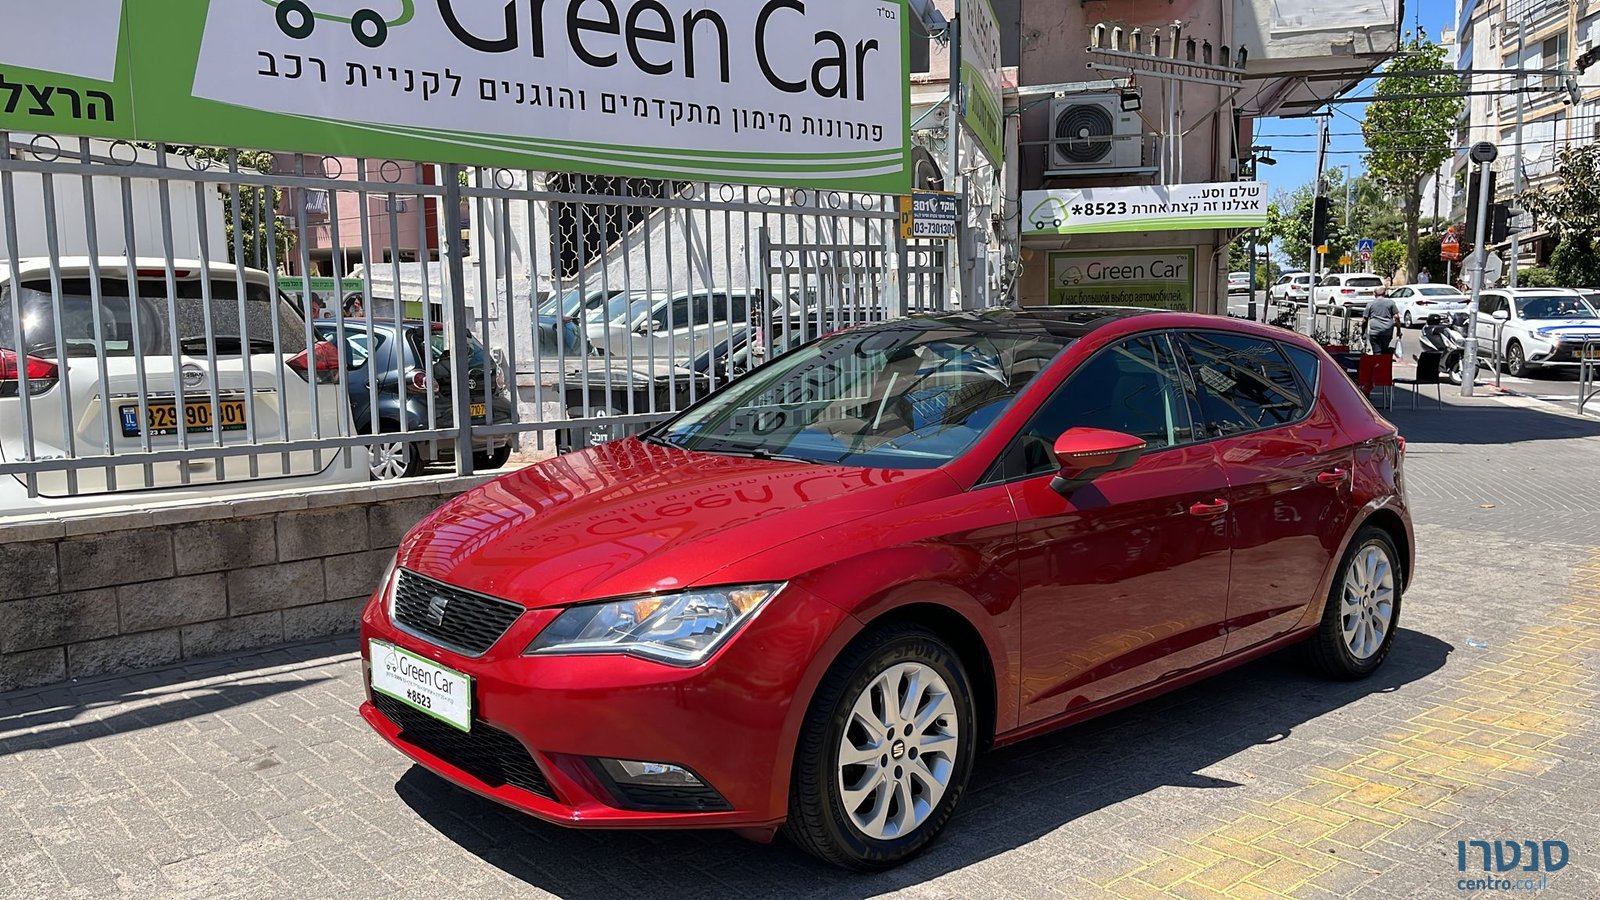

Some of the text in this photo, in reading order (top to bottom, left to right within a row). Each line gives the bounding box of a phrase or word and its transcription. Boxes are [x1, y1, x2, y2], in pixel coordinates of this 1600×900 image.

[437, 0, 730, 84] Green
[755, 0, 879, 101] Car
[257, 51, 883, 143] פתרונות מימון מתקדמים והוגנים לקניית רכב
[1189, 186, 1260, 199] שלם וסע...
[913, 200, 930, 212] 301
[1131, 204, 1168, 215] אחרת
[1170, 203, 1199, 215] קצת
[1203, 201, 1218, 212] זה
[1222, 199, 1260, 211] אצלנו
[1086, 260, 1184, 280] Green Car
[399, 656, 433, 687] Green
[433, 670, 454, 695] Car
